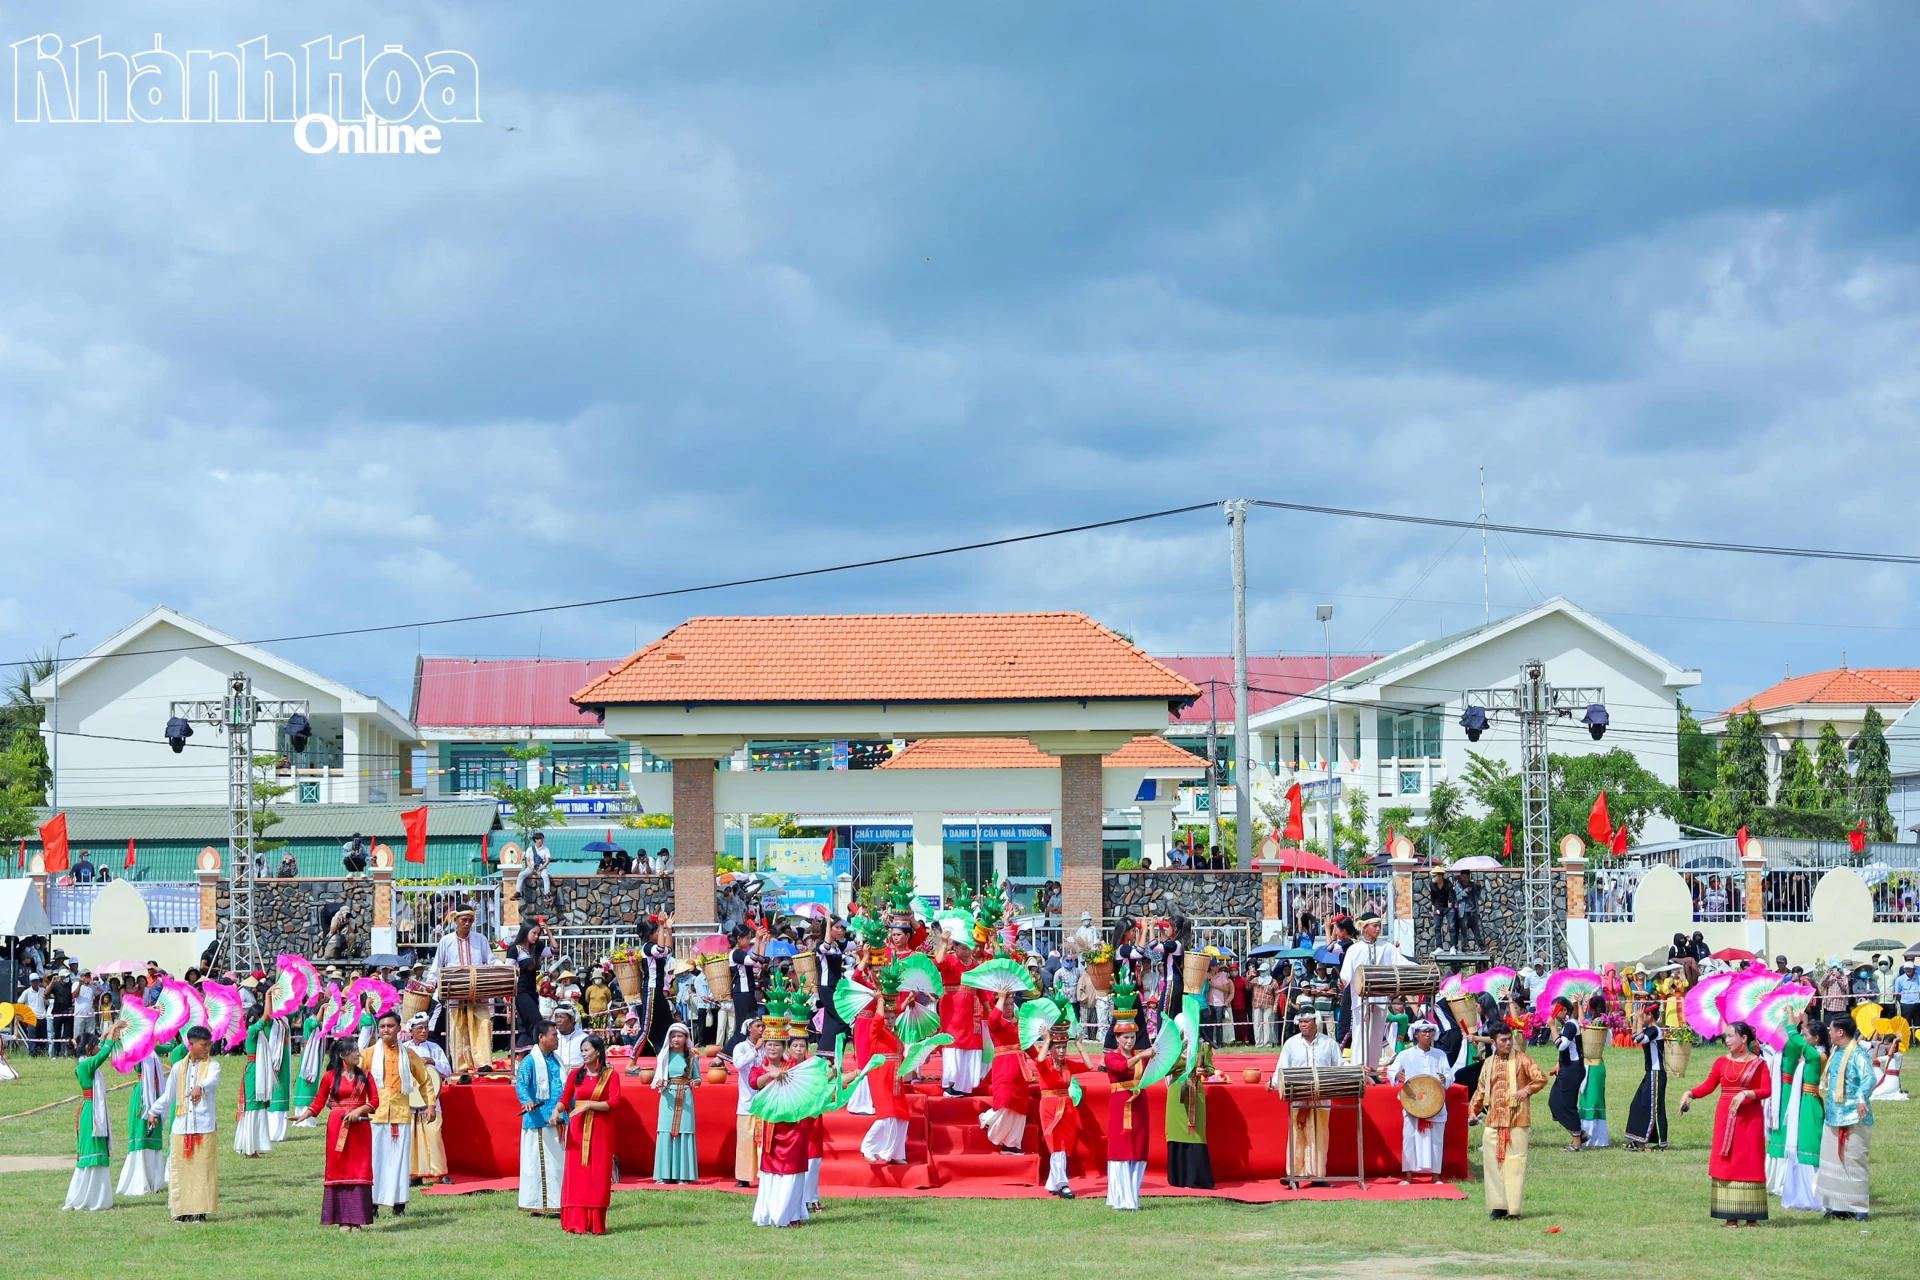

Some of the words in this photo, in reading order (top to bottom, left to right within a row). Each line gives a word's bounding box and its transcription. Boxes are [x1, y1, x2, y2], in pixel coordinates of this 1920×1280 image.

[571, 802, 589, 812] TRANG
[594, 801, 604, 812] LỚP
[855, 828, 874, 838] CHẤT
[876, 829, 900, 840] LƯỢNG
[949, 828, 969, 838] DANH
[984, 827, 998, 838] CỦA
[1000, 827, 1016, 838] NHÀ
[1018, 826, 1048, 838] TRƯỜNG
